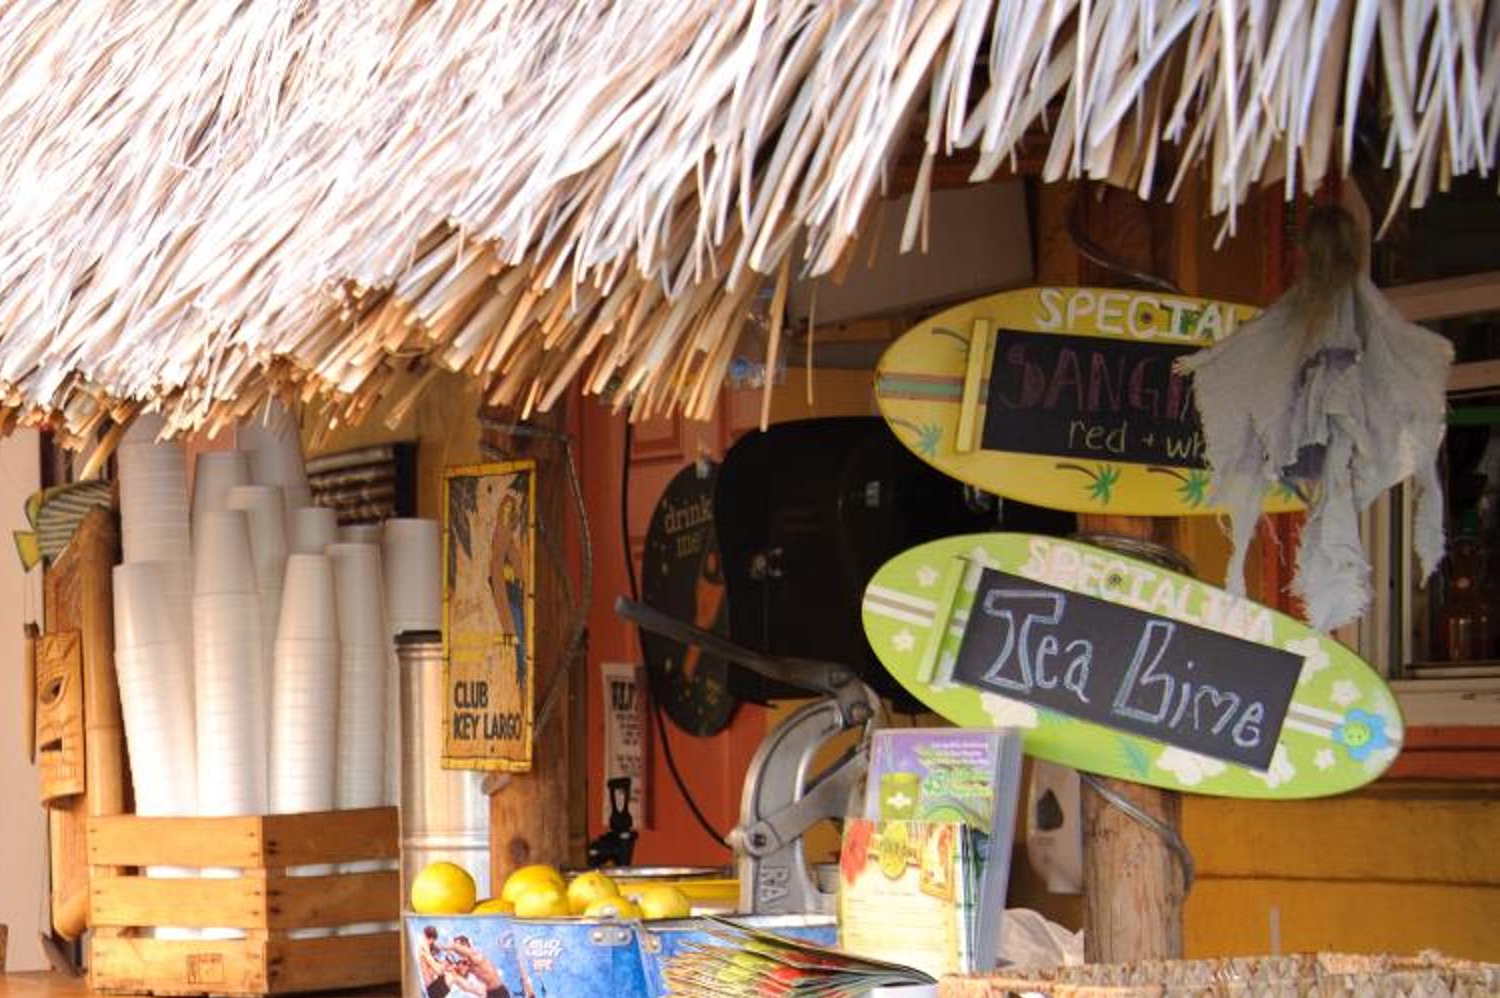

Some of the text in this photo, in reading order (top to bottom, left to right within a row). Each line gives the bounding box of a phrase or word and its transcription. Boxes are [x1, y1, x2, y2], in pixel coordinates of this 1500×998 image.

[1034, 288, 1264, 341] SPECIAL
[1069, 420, 1128, 452] red
[982, 590, 1094, 702] Tea
[453, 680, 489, 708] CLUB
[453, 713, 522, 740] KEY LARGO
